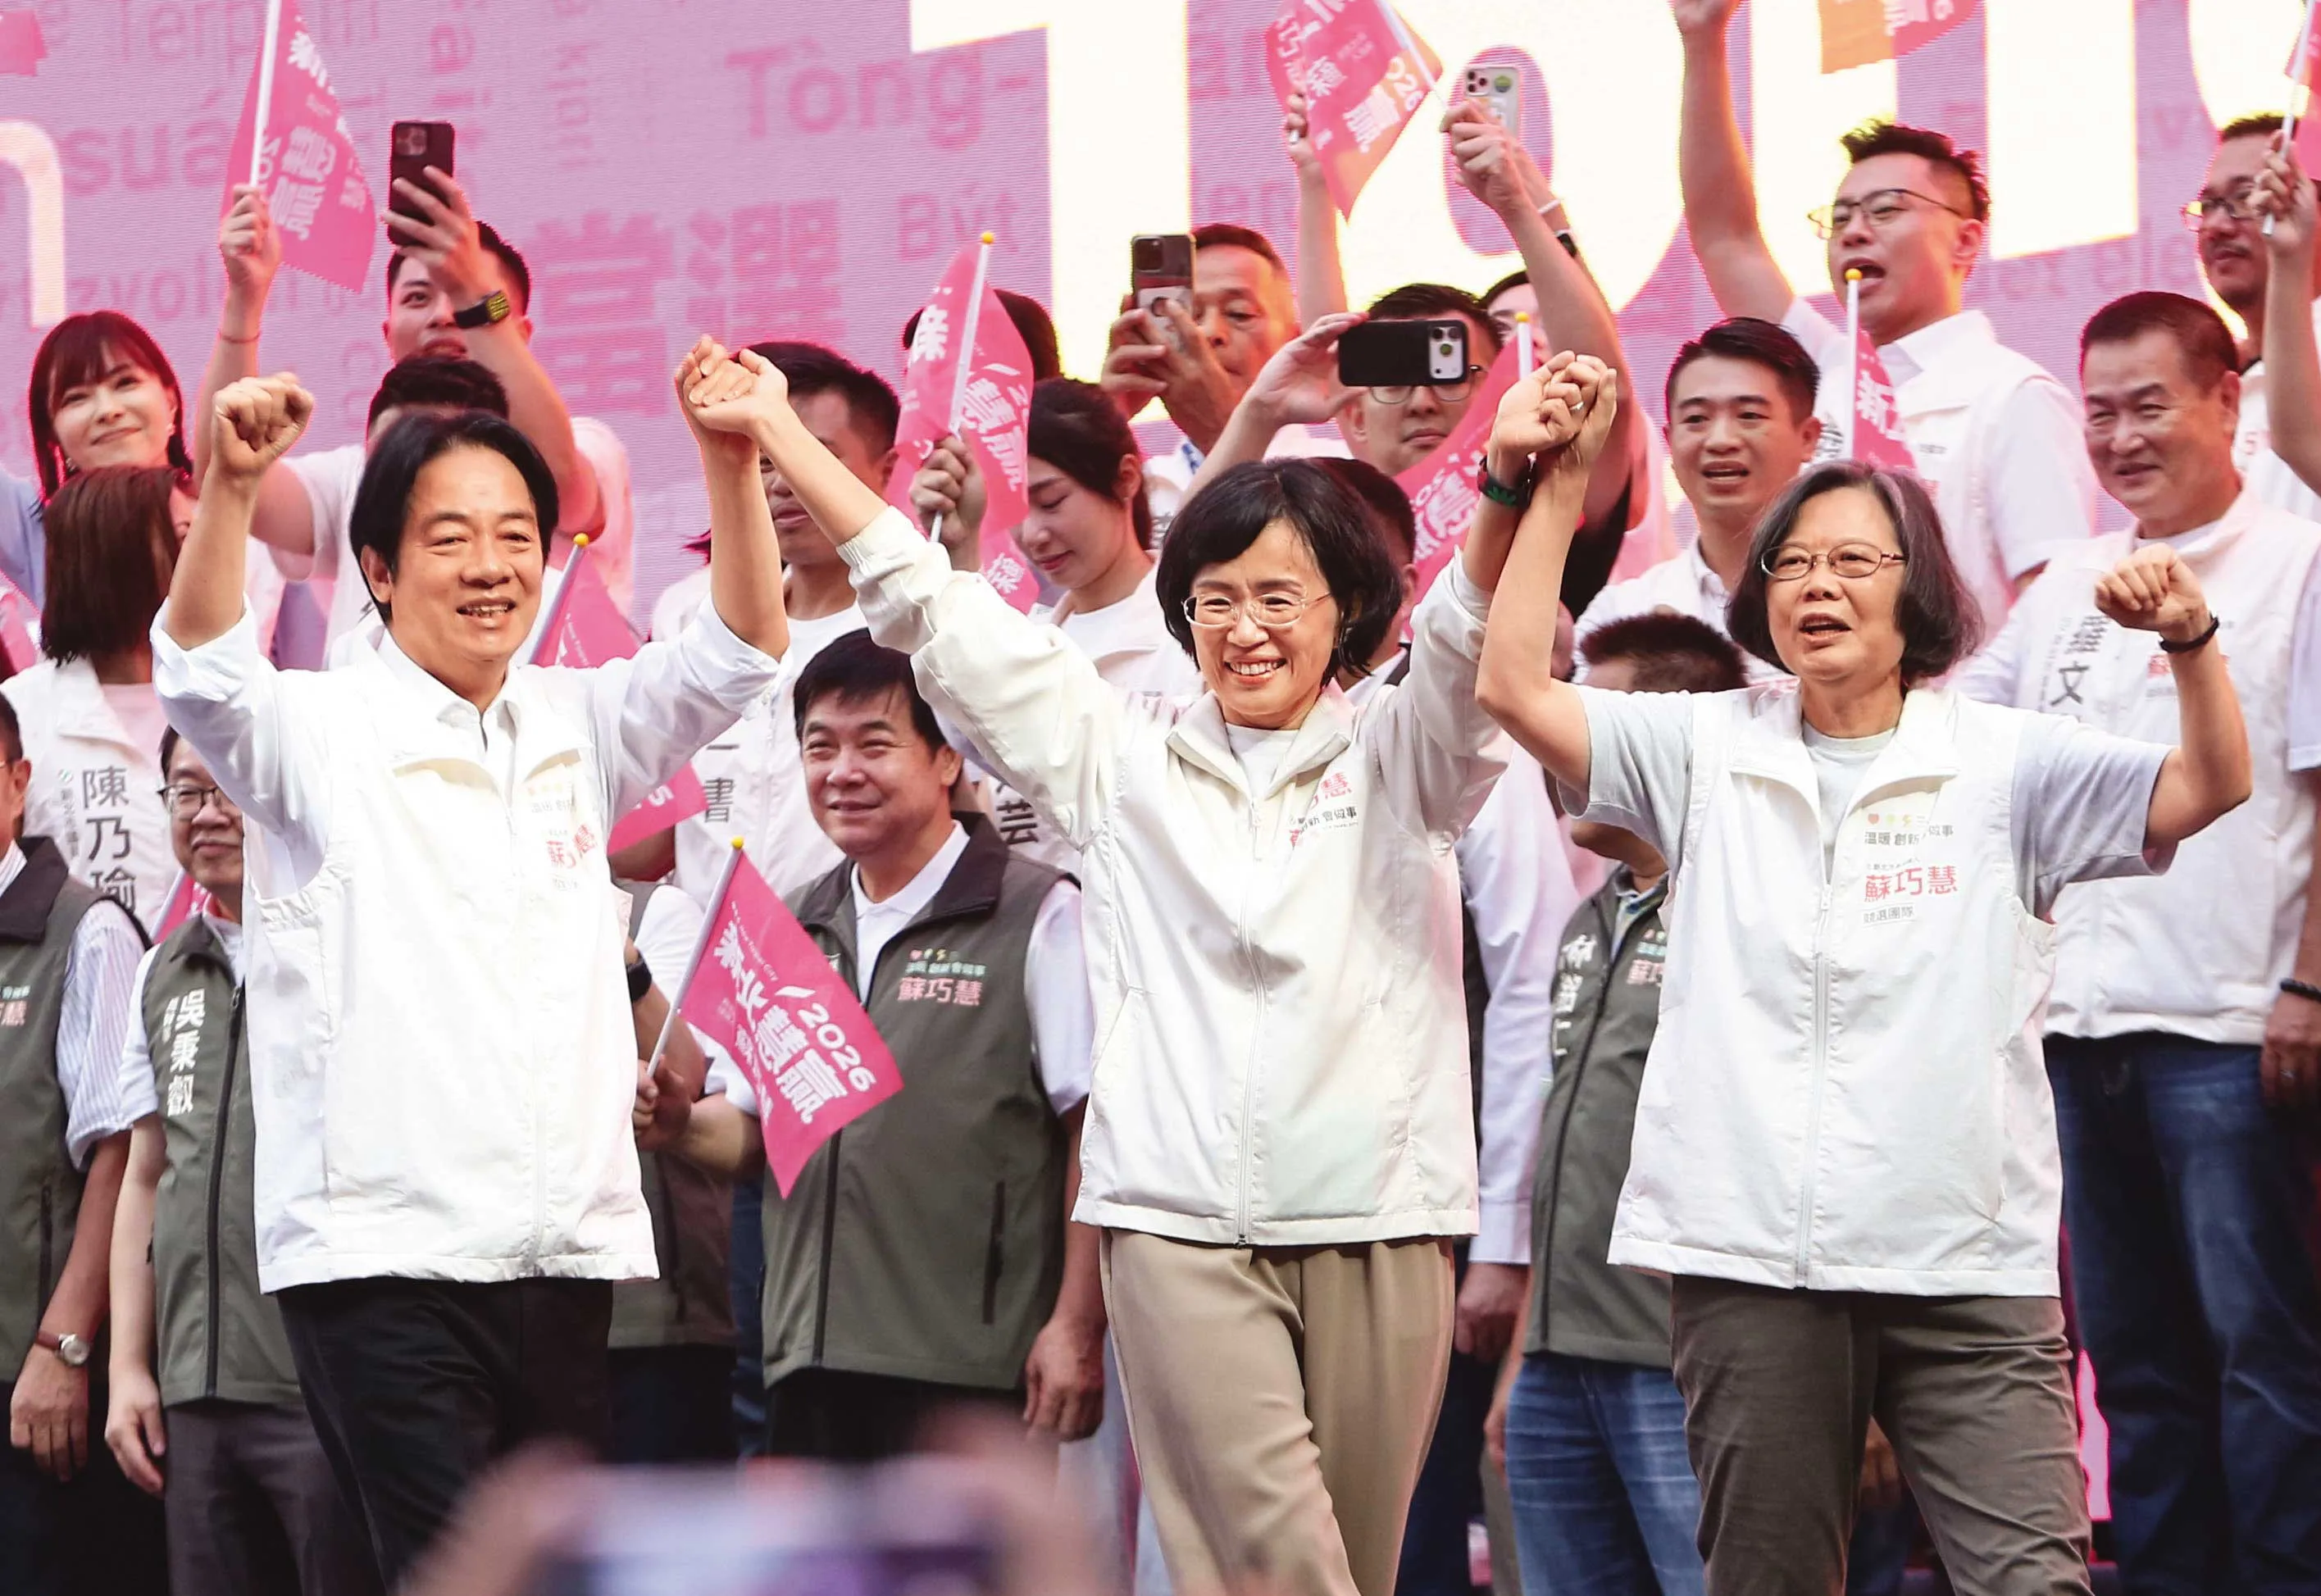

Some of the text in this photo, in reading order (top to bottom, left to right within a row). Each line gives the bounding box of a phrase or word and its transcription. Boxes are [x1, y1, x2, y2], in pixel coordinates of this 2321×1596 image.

[721, 37, 1031, 152] Tòng-
[82, 765, 137, 915] 陳乃瑜
[1864, 865, 1959, 903] 蘇巧慧
[897, 976, 984, 1007] 蘇巧慧
[166, 987, 207, 1118] 吳秉叡
[797, 1002, 878, 1093] 2026
